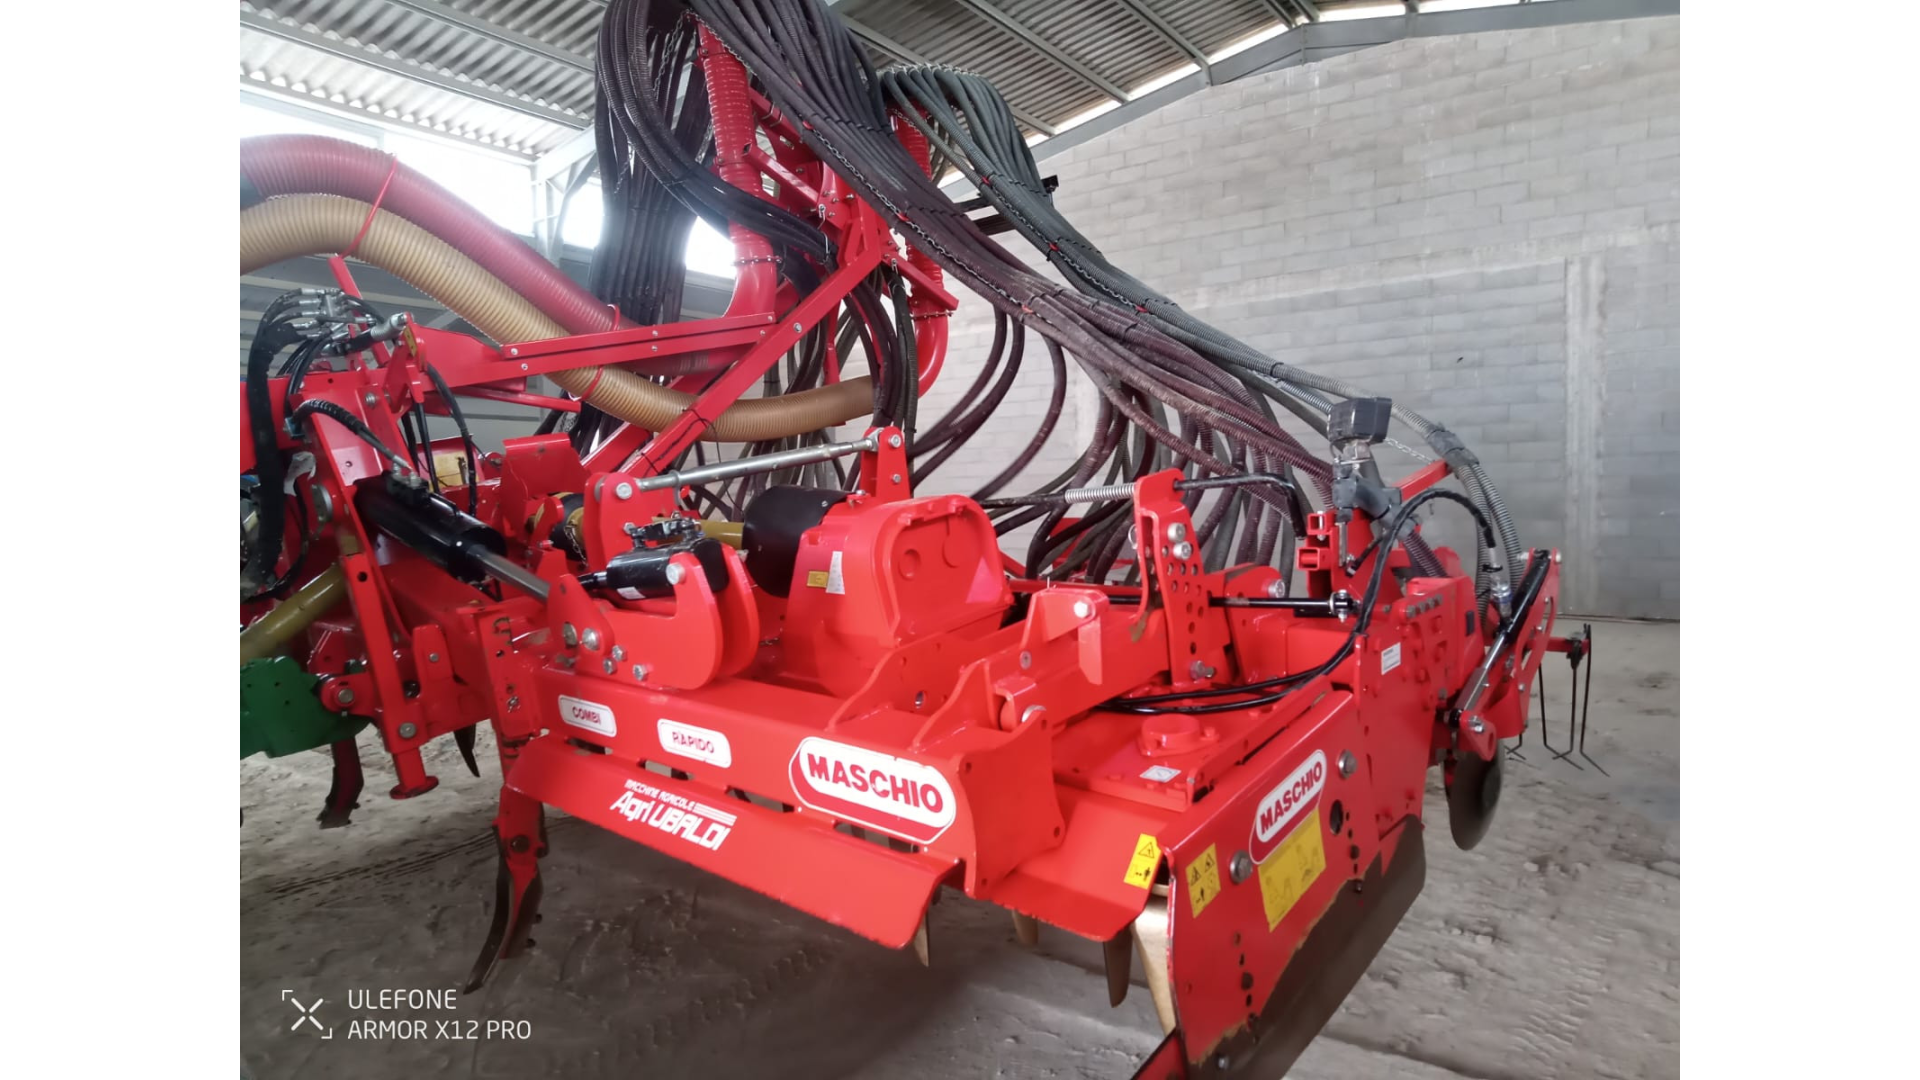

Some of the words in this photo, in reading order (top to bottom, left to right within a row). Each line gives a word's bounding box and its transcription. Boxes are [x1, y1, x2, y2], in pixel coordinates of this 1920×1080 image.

[571, 705, 602, 726] COMBI
[671, 730, 715, 754] RAPIDO
[624, 779, 660, 799] MACCHINE
[658, 791, 696, 812] AGRICOLE
[807, 752, 943, 814] MASCHIO
[1260, 761, 1322, 836] MASCHIO
